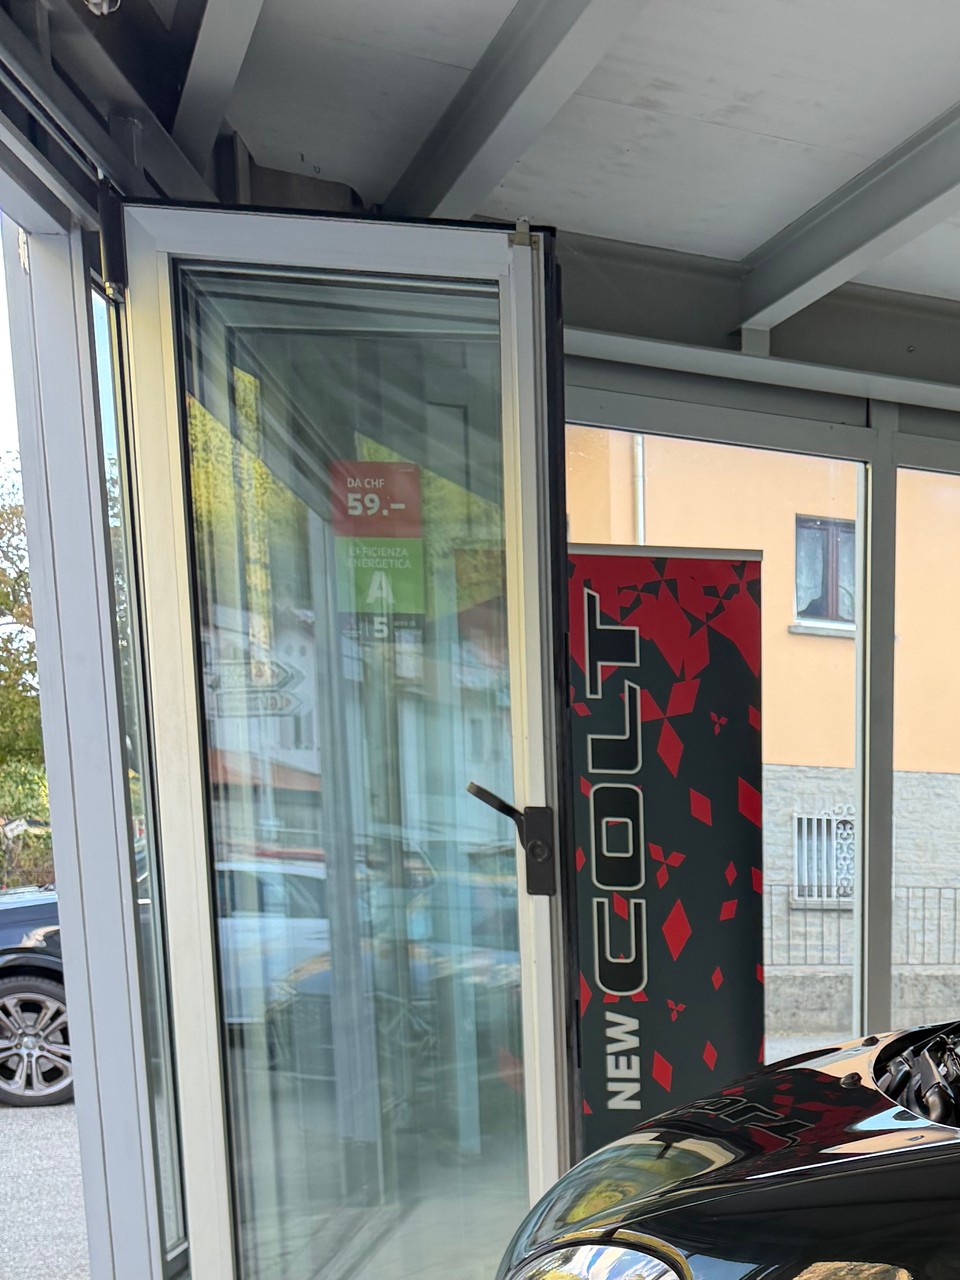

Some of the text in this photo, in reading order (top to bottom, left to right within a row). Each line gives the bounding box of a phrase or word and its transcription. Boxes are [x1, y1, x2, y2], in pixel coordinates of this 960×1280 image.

[347, 478, 385, 488] DA CHF
[366, 571, 395, 603] A
[373, 616, 389, 638] 5
[583, 587, 648, 1111] NEW COLT
